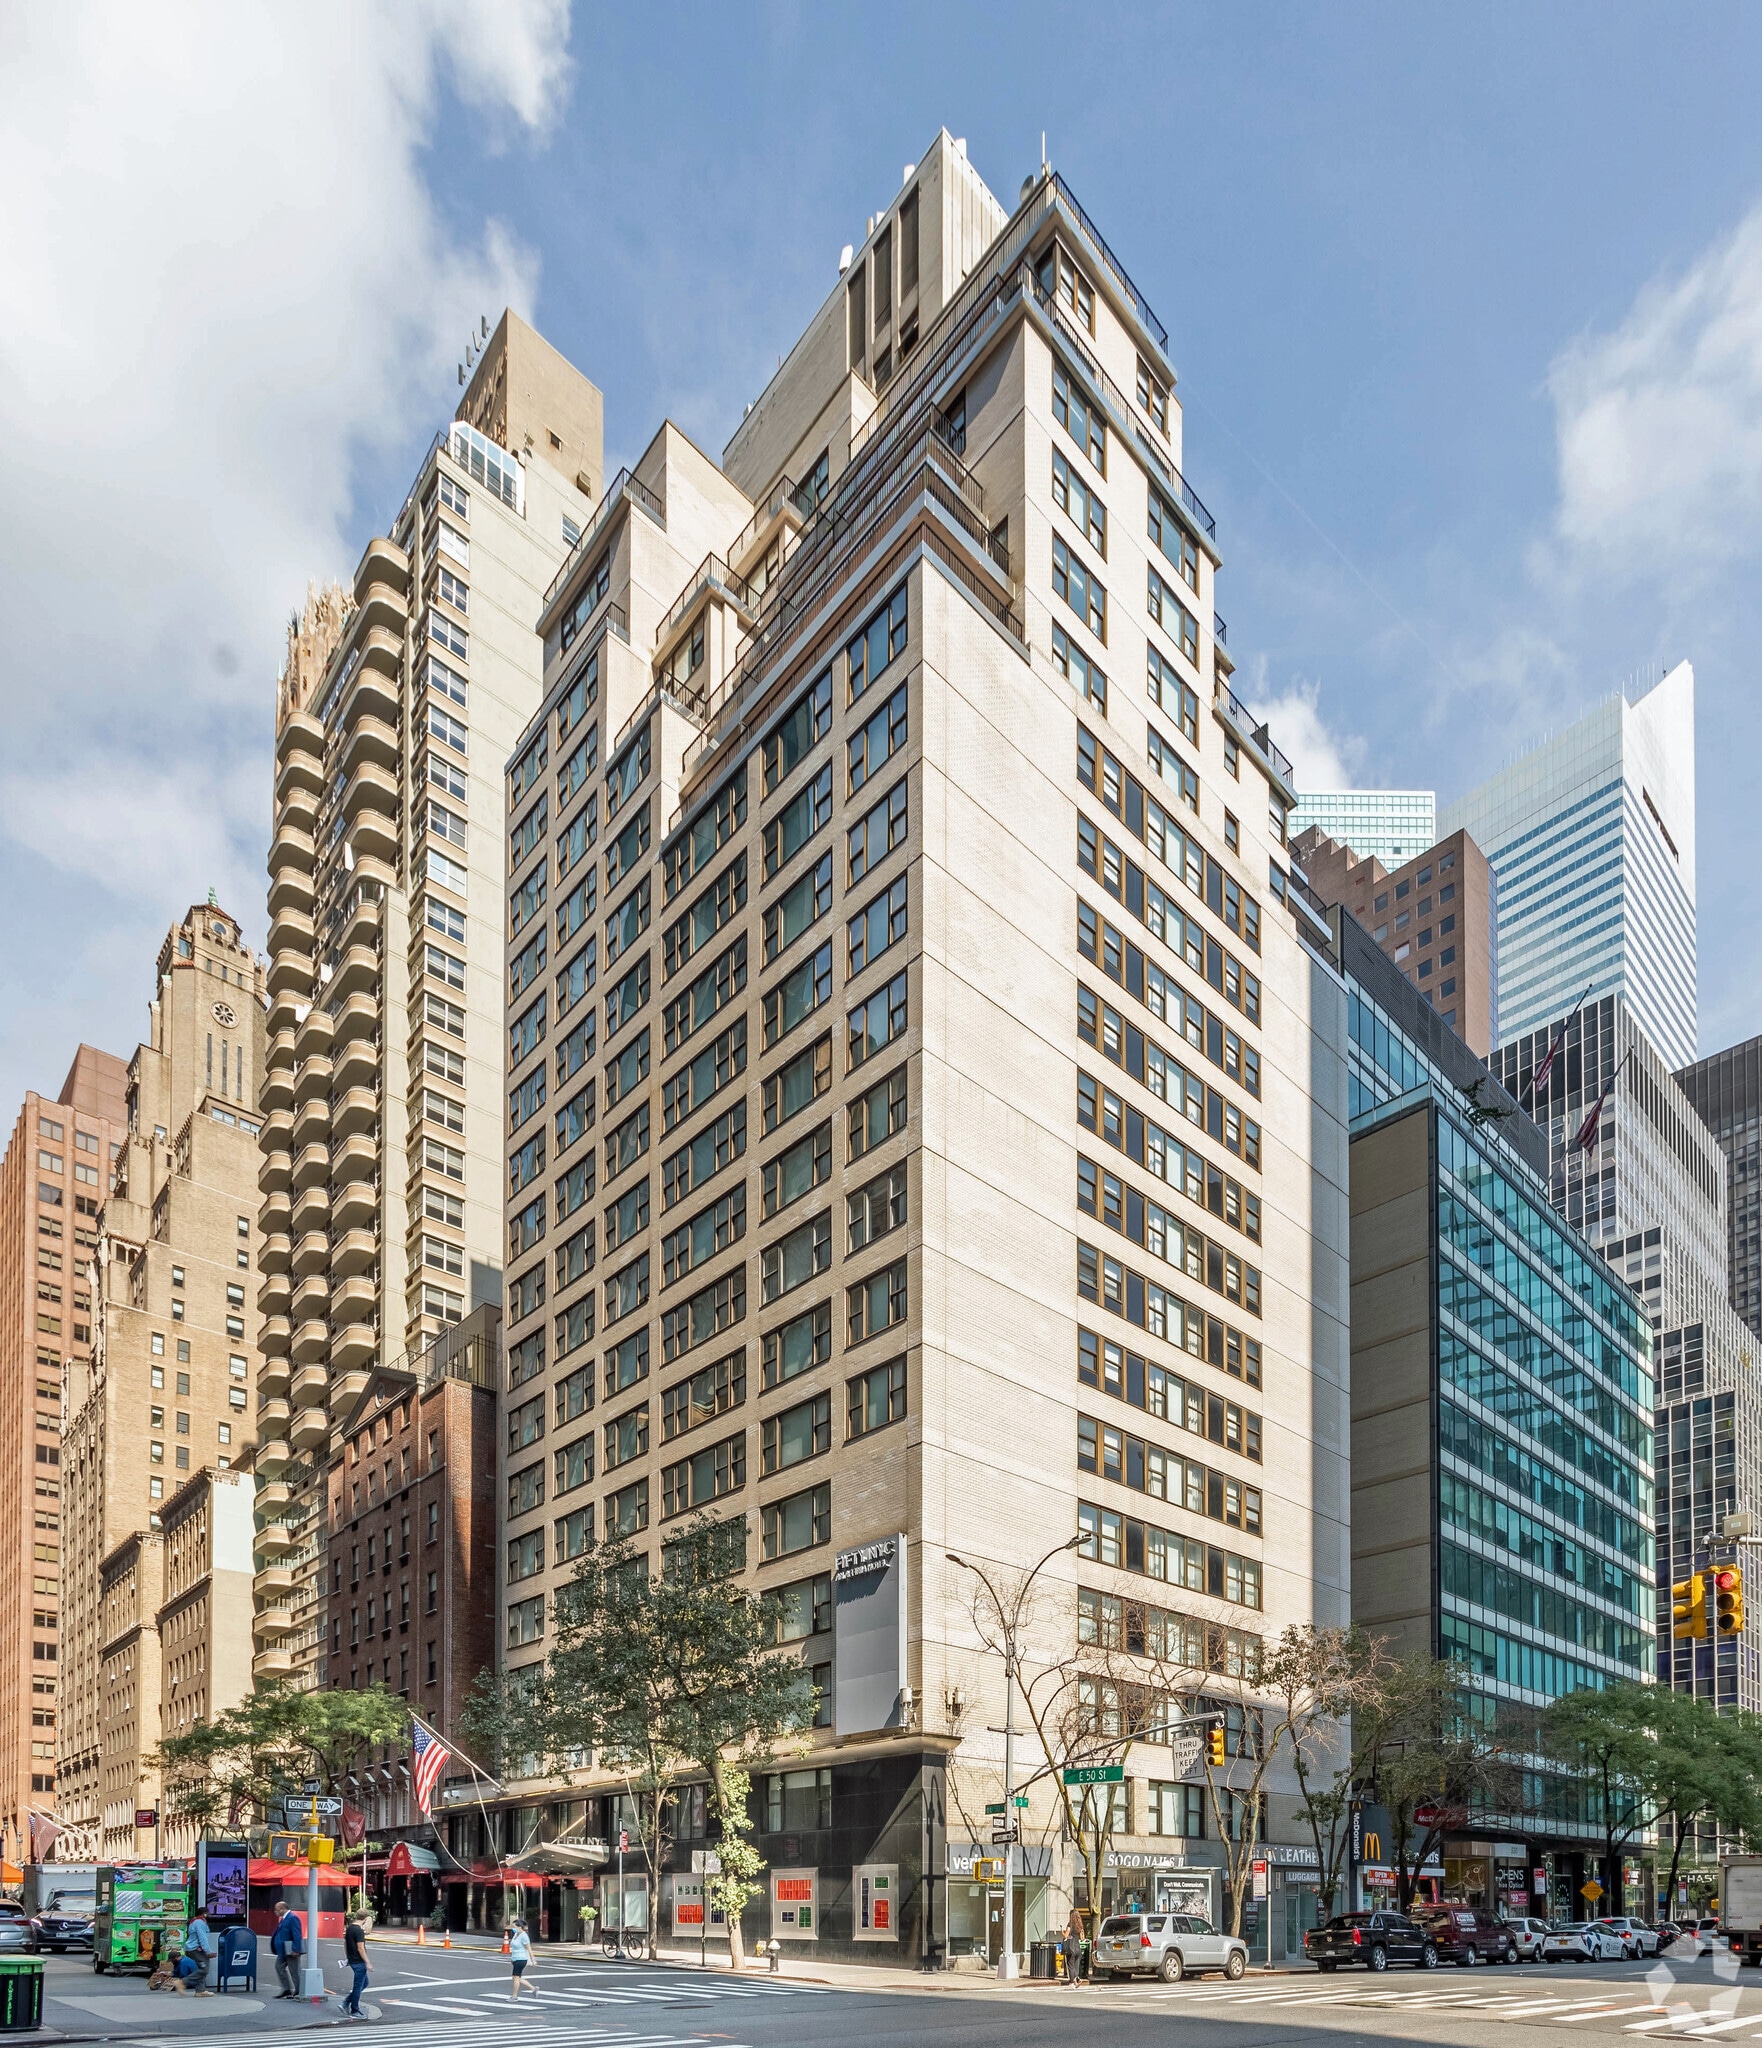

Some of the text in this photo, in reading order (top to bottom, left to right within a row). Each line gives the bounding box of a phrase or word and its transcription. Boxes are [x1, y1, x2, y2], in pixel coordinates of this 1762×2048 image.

[835, 1549, 865, 1570] FIFTY
[868, 1540, 896, 1560] NYC
[1179, 1741, 1197, 1749] THRU
[1175, 1749, 1202, 1758] TRAFFIC
[1179, 1758, 1198, 1767] KEEP
[1079, 1769, 1107, 1781] E 50 St
[1180, 1767, 1198, 1775] LEFT
[290, 1801, 308, 1809] ONE
[557, 1836, 607, 1846] FIFTY NYC
[286, 1842, 297, 1858] 15
[1107, 1854, 1141, 1867] SOGO
[1280, 1848, 1320, 1864] LEATHE
[953, 1853, 1002, 1871] verin
[1288, 1873, 1319, 1881] LUGGAGE
